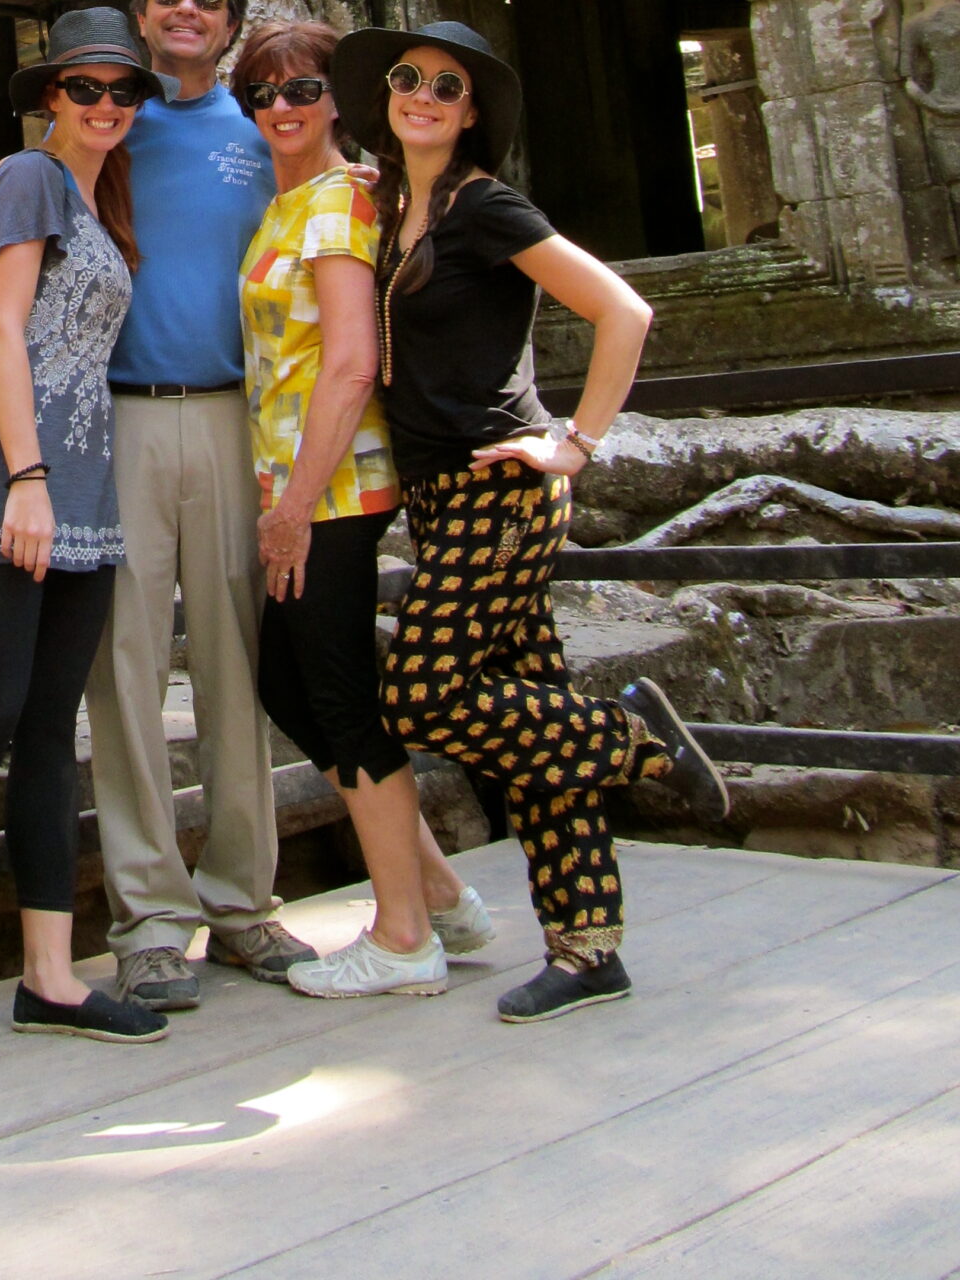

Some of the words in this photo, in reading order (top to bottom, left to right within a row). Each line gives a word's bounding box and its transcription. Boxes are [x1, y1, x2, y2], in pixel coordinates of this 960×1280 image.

[225, 142, 244, 154] The
[208, 151, 261, 168] Transformed
[217, 162, 254, 177] Traveler
[223, 174, 248, 185] Show
